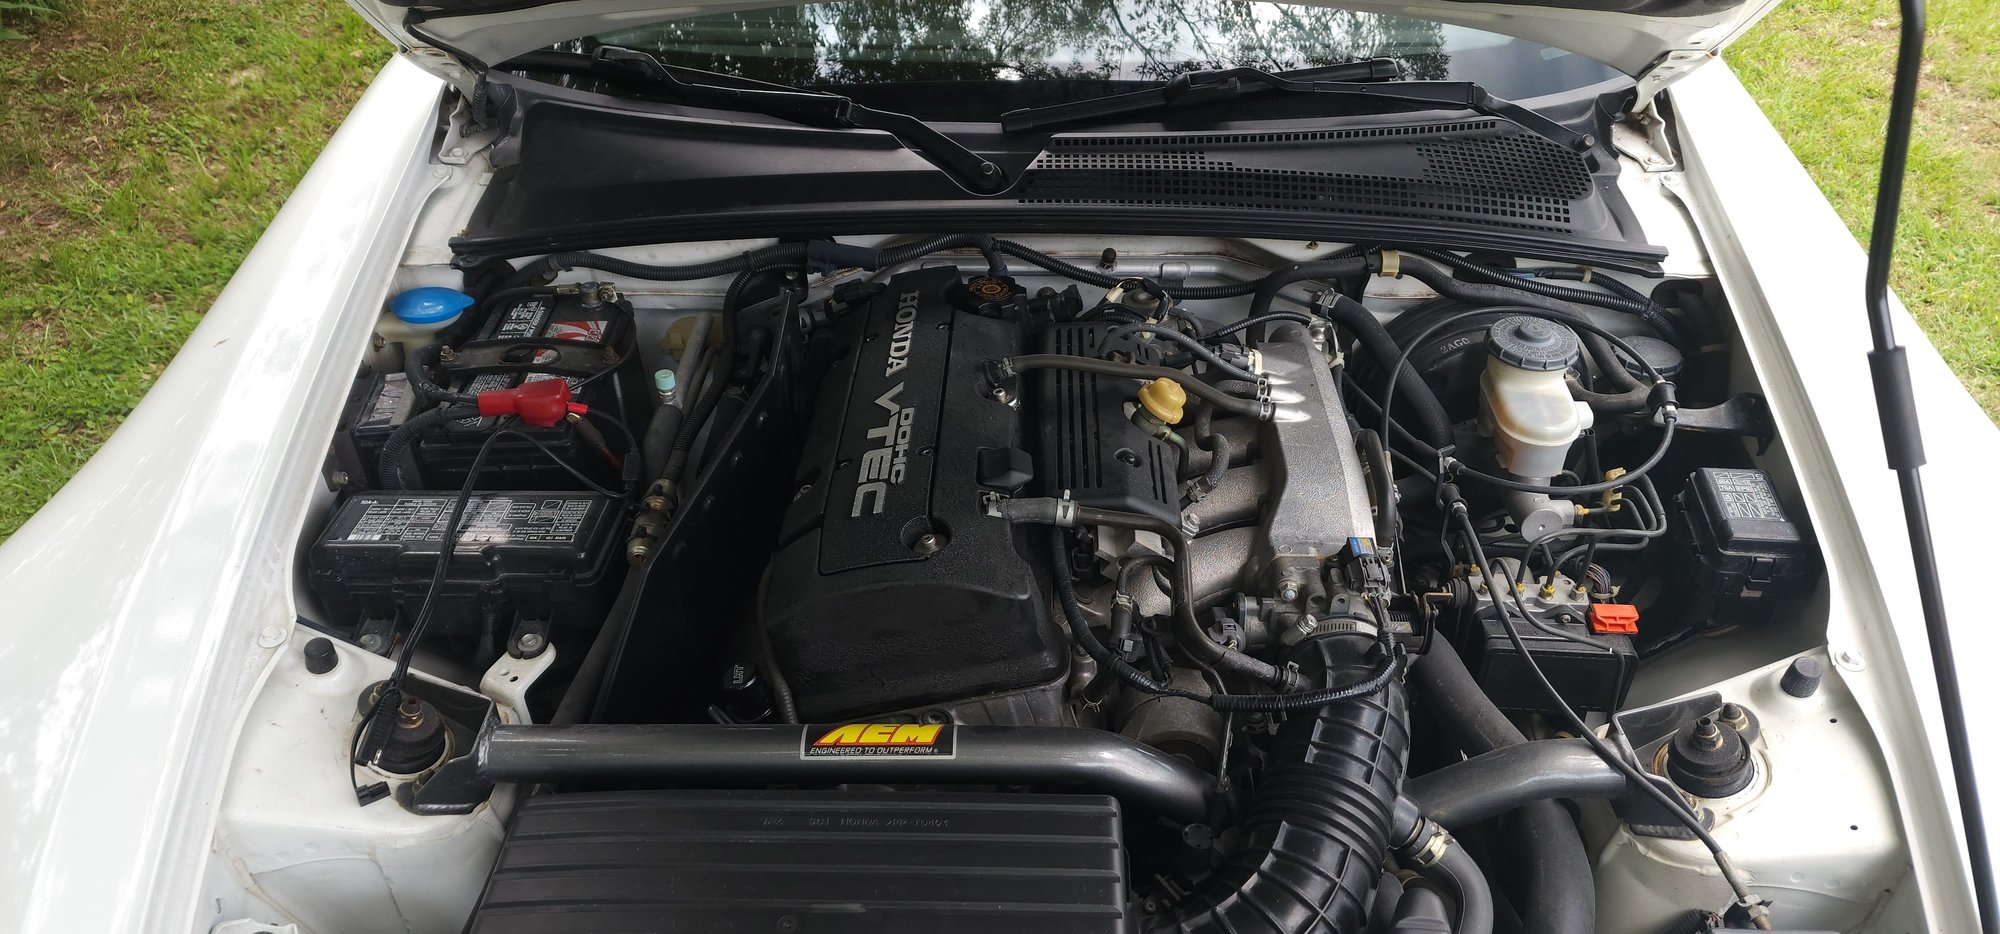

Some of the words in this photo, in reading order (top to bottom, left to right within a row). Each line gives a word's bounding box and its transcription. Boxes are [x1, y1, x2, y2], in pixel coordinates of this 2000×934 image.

[885, 289, 919, 378] HONDA
[851, 381, 905, 518] VTEC
[890, 407, 915, 485] DOHC
[810, 746, 862, 755] ENGINEERED
[864, 746, 874, 755] TO
[812, 723, 944, 746] AEM
